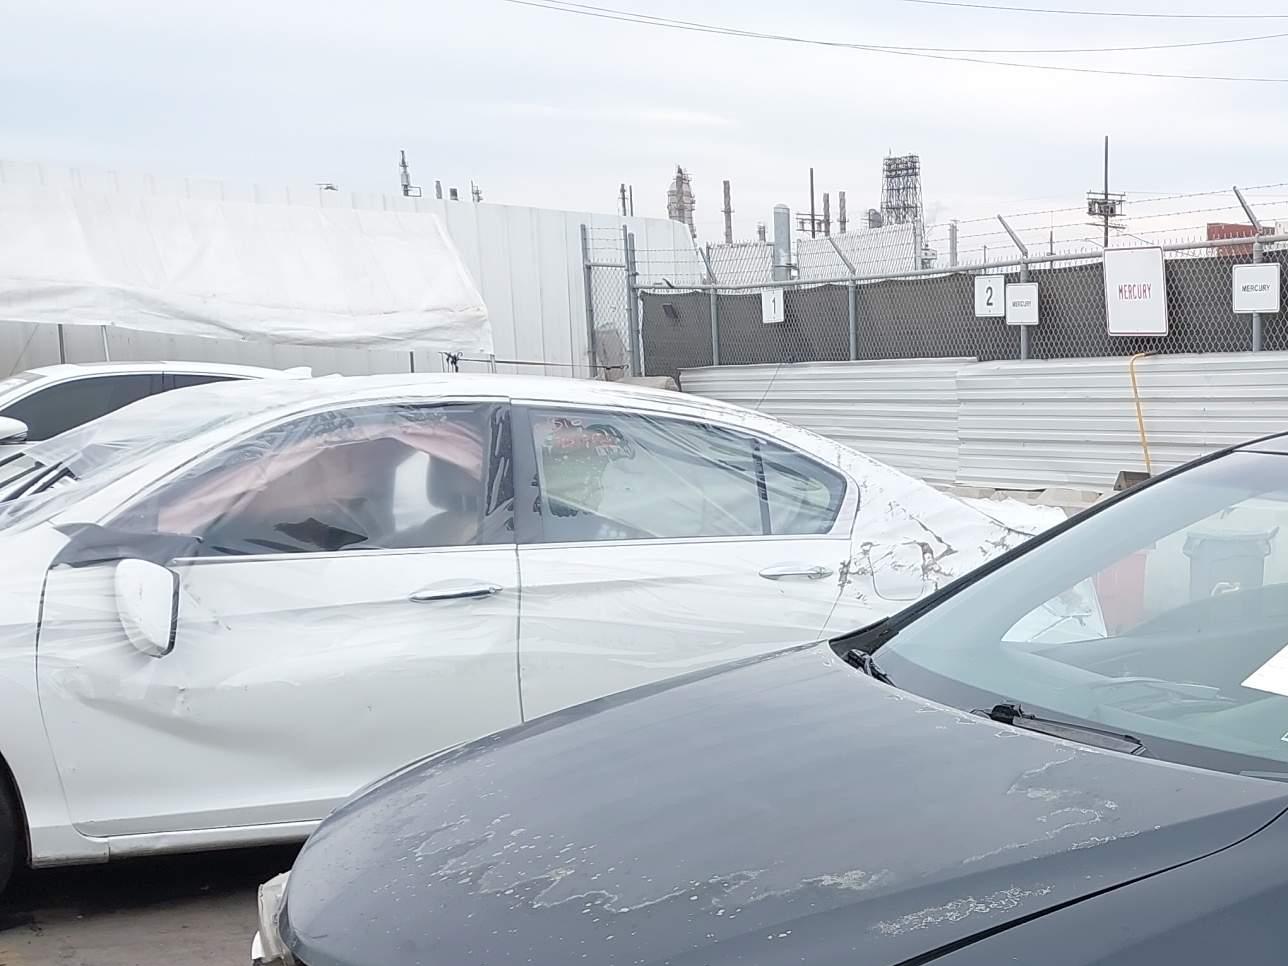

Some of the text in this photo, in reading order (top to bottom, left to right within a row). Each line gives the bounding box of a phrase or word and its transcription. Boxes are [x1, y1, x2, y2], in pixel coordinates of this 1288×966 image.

[985, 286, 993, 306] 2
[1118, 283, 1152, 300] MERCURY
[1241, 283, 1271, 293] MERCURY
